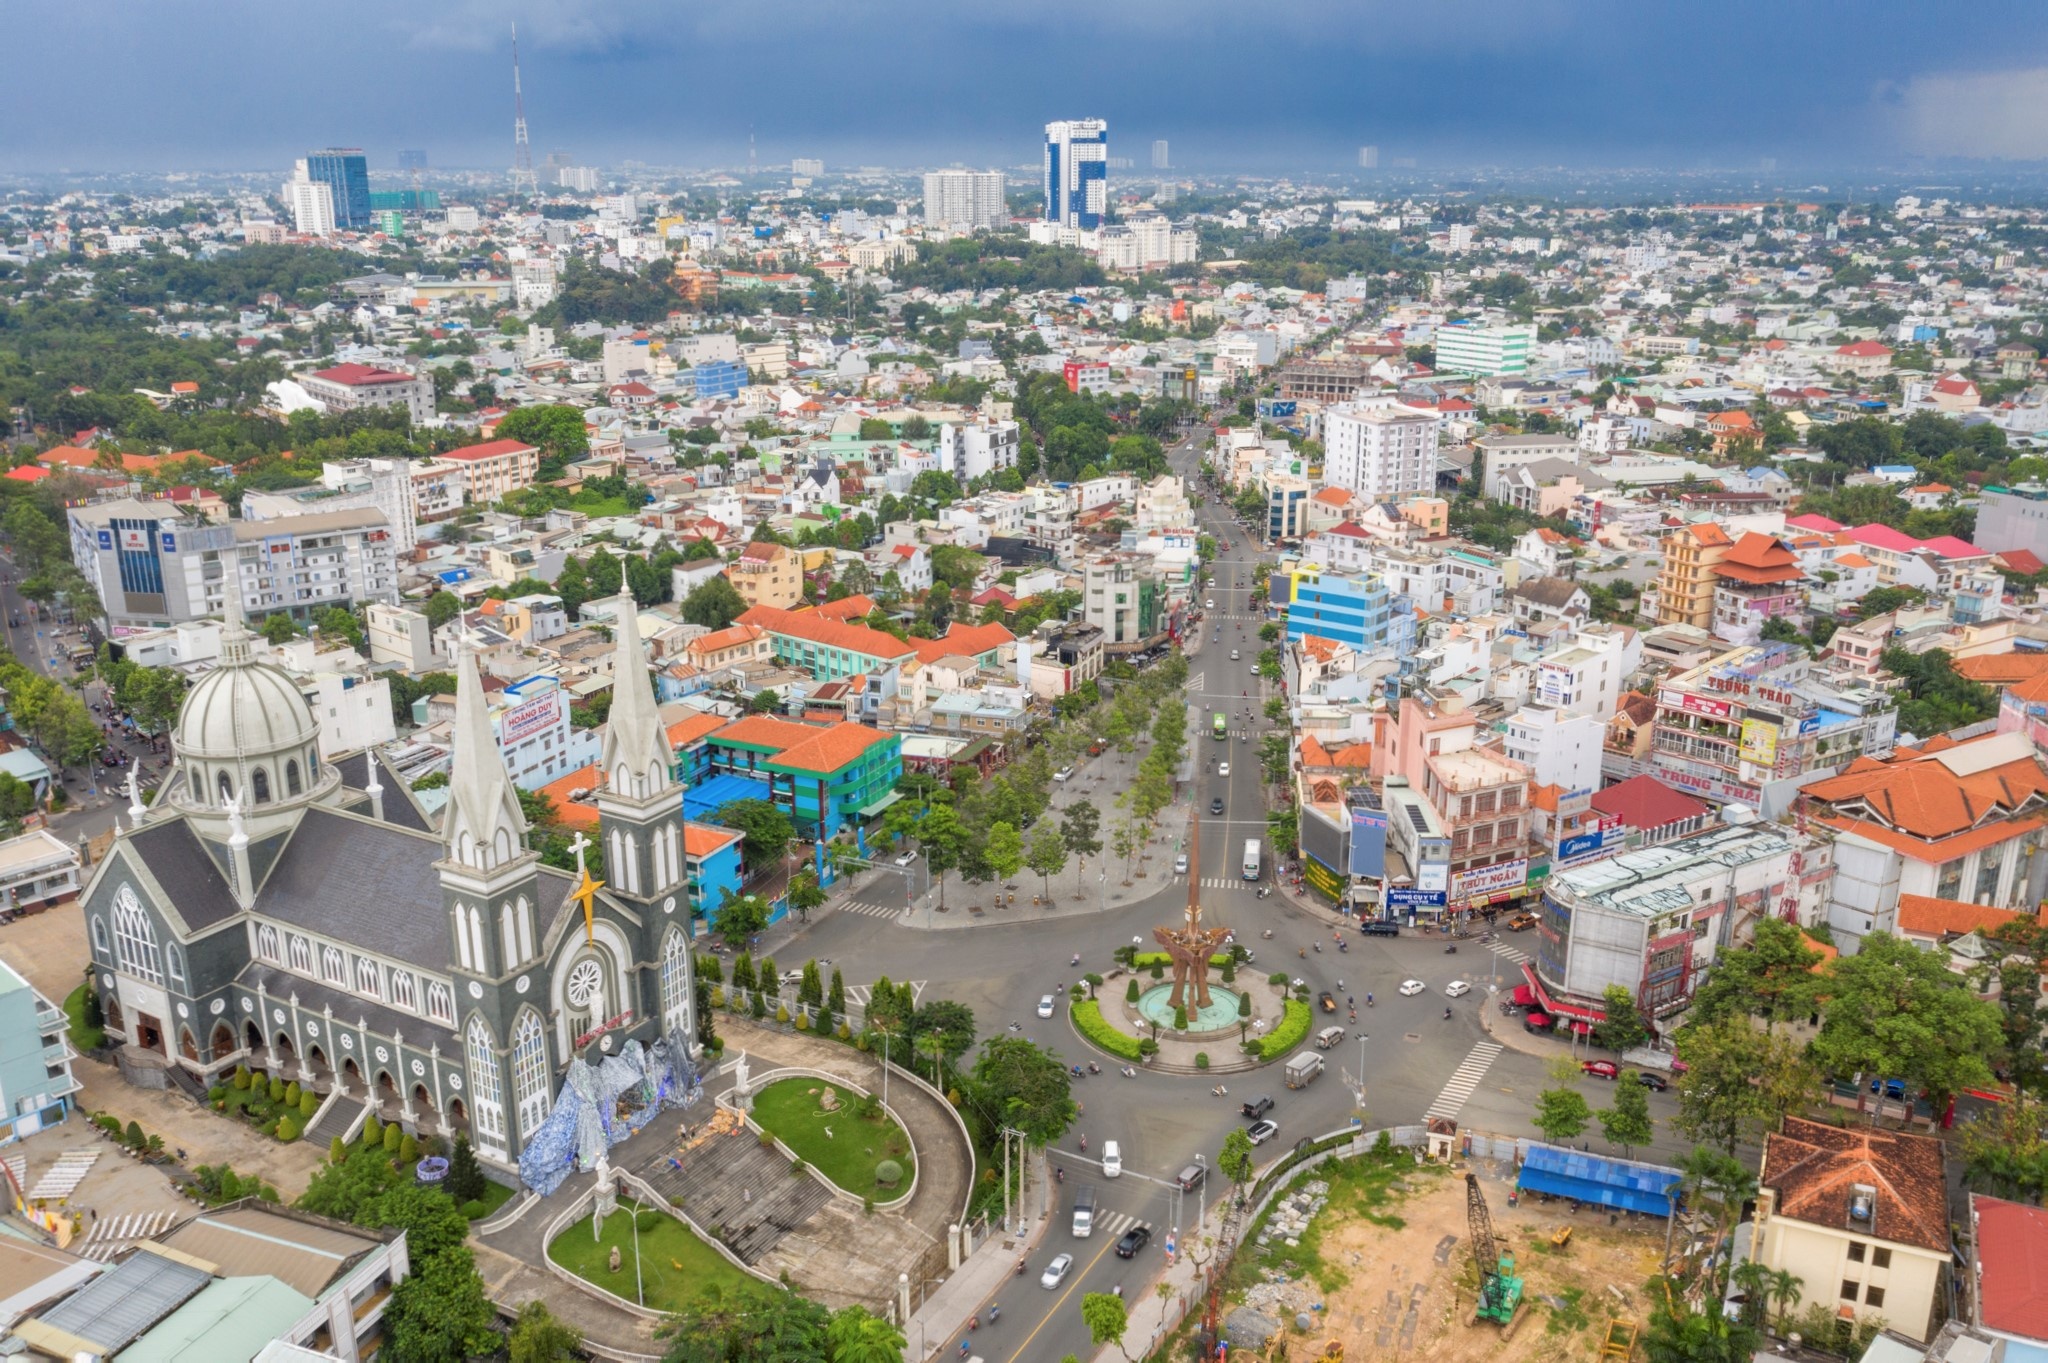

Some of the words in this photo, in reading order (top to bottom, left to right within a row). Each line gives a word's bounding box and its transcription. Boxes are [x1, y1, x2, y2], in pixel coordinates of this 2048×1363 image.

[1708, 676, 1750, 695] TRUNG
[1758, 686, 1792, 705] THẢO
[508, 708, 537, 727] HOÀNG
[538, 701, 553, 714] DUY
[1660, 768, 1711, 790] TRUNG
[1489, 869, 1518, 884] NGÂN
